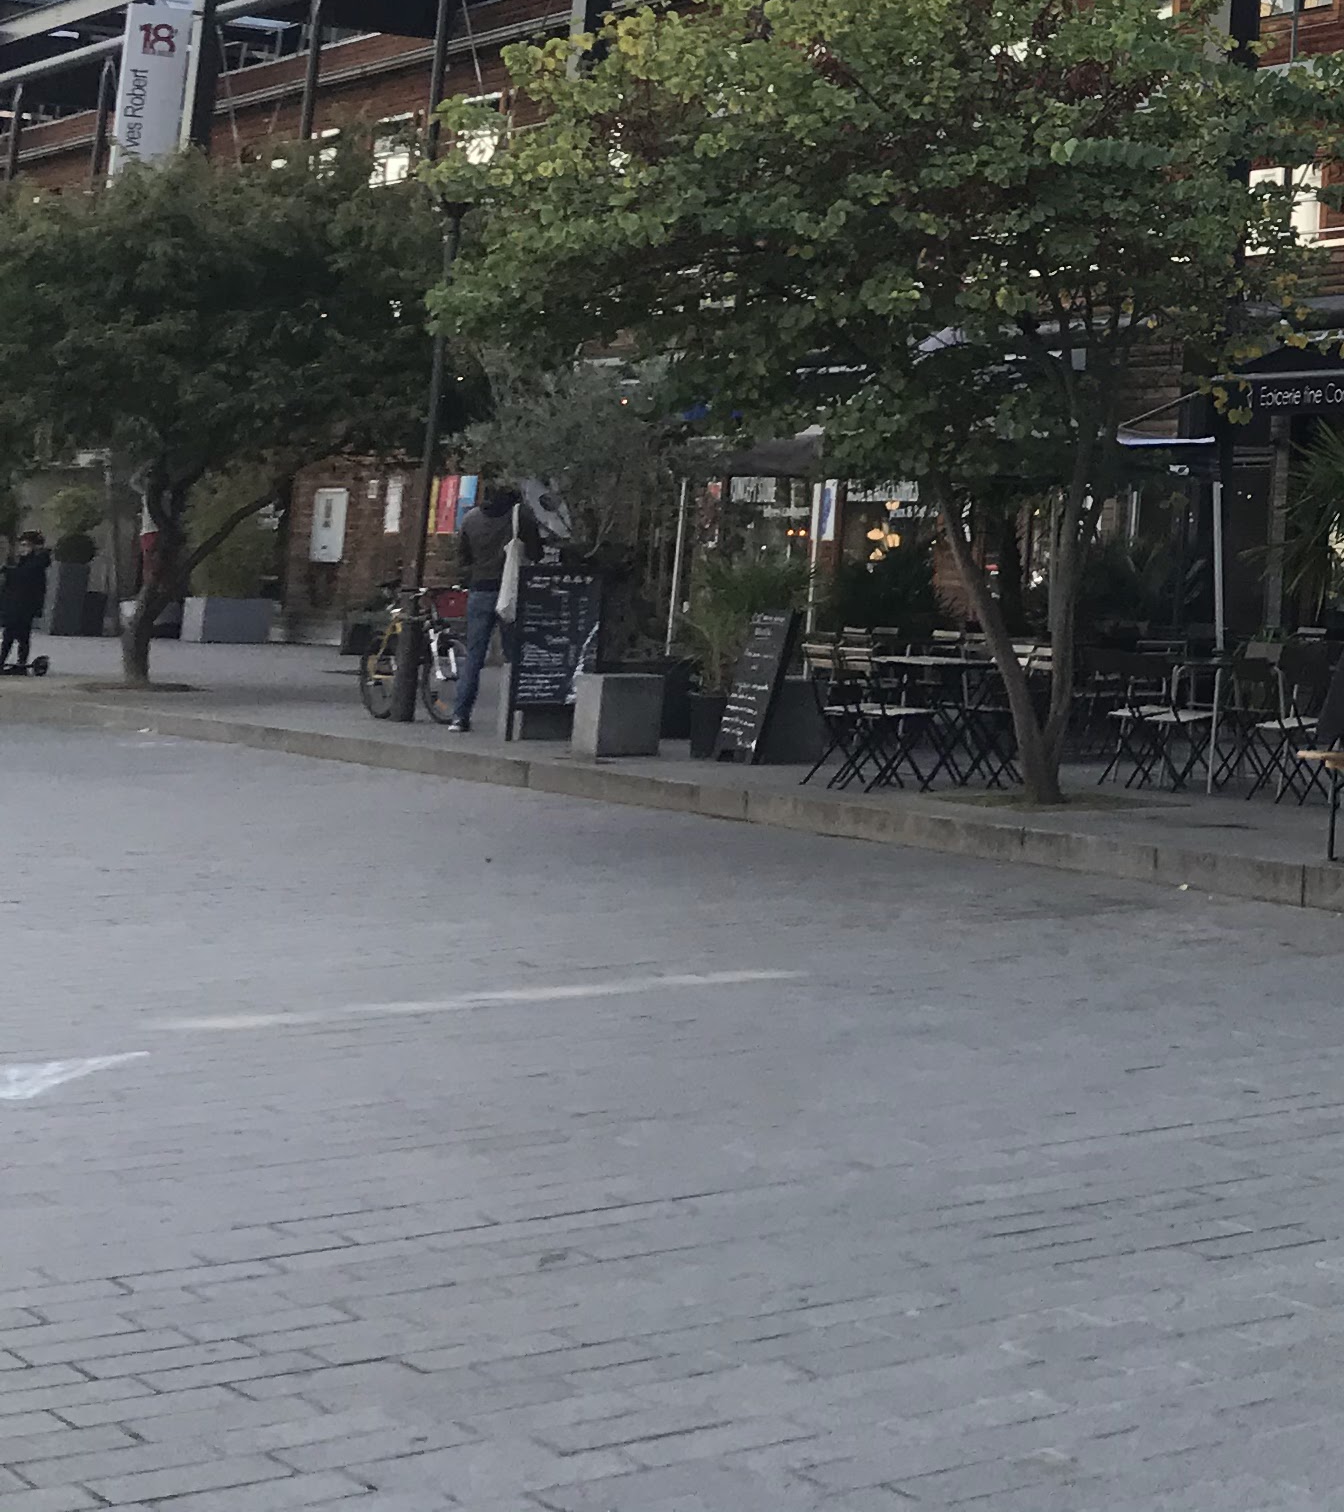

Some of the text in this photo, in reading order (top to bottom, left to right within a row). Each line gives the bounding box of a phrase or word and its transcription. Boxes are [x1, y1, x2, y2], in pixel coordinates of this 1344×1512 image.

[123, 68, 149, 119] Robert
[1260, 386, 1301, 408] Epicerie
[1303, 385, 1323, 404] fine
